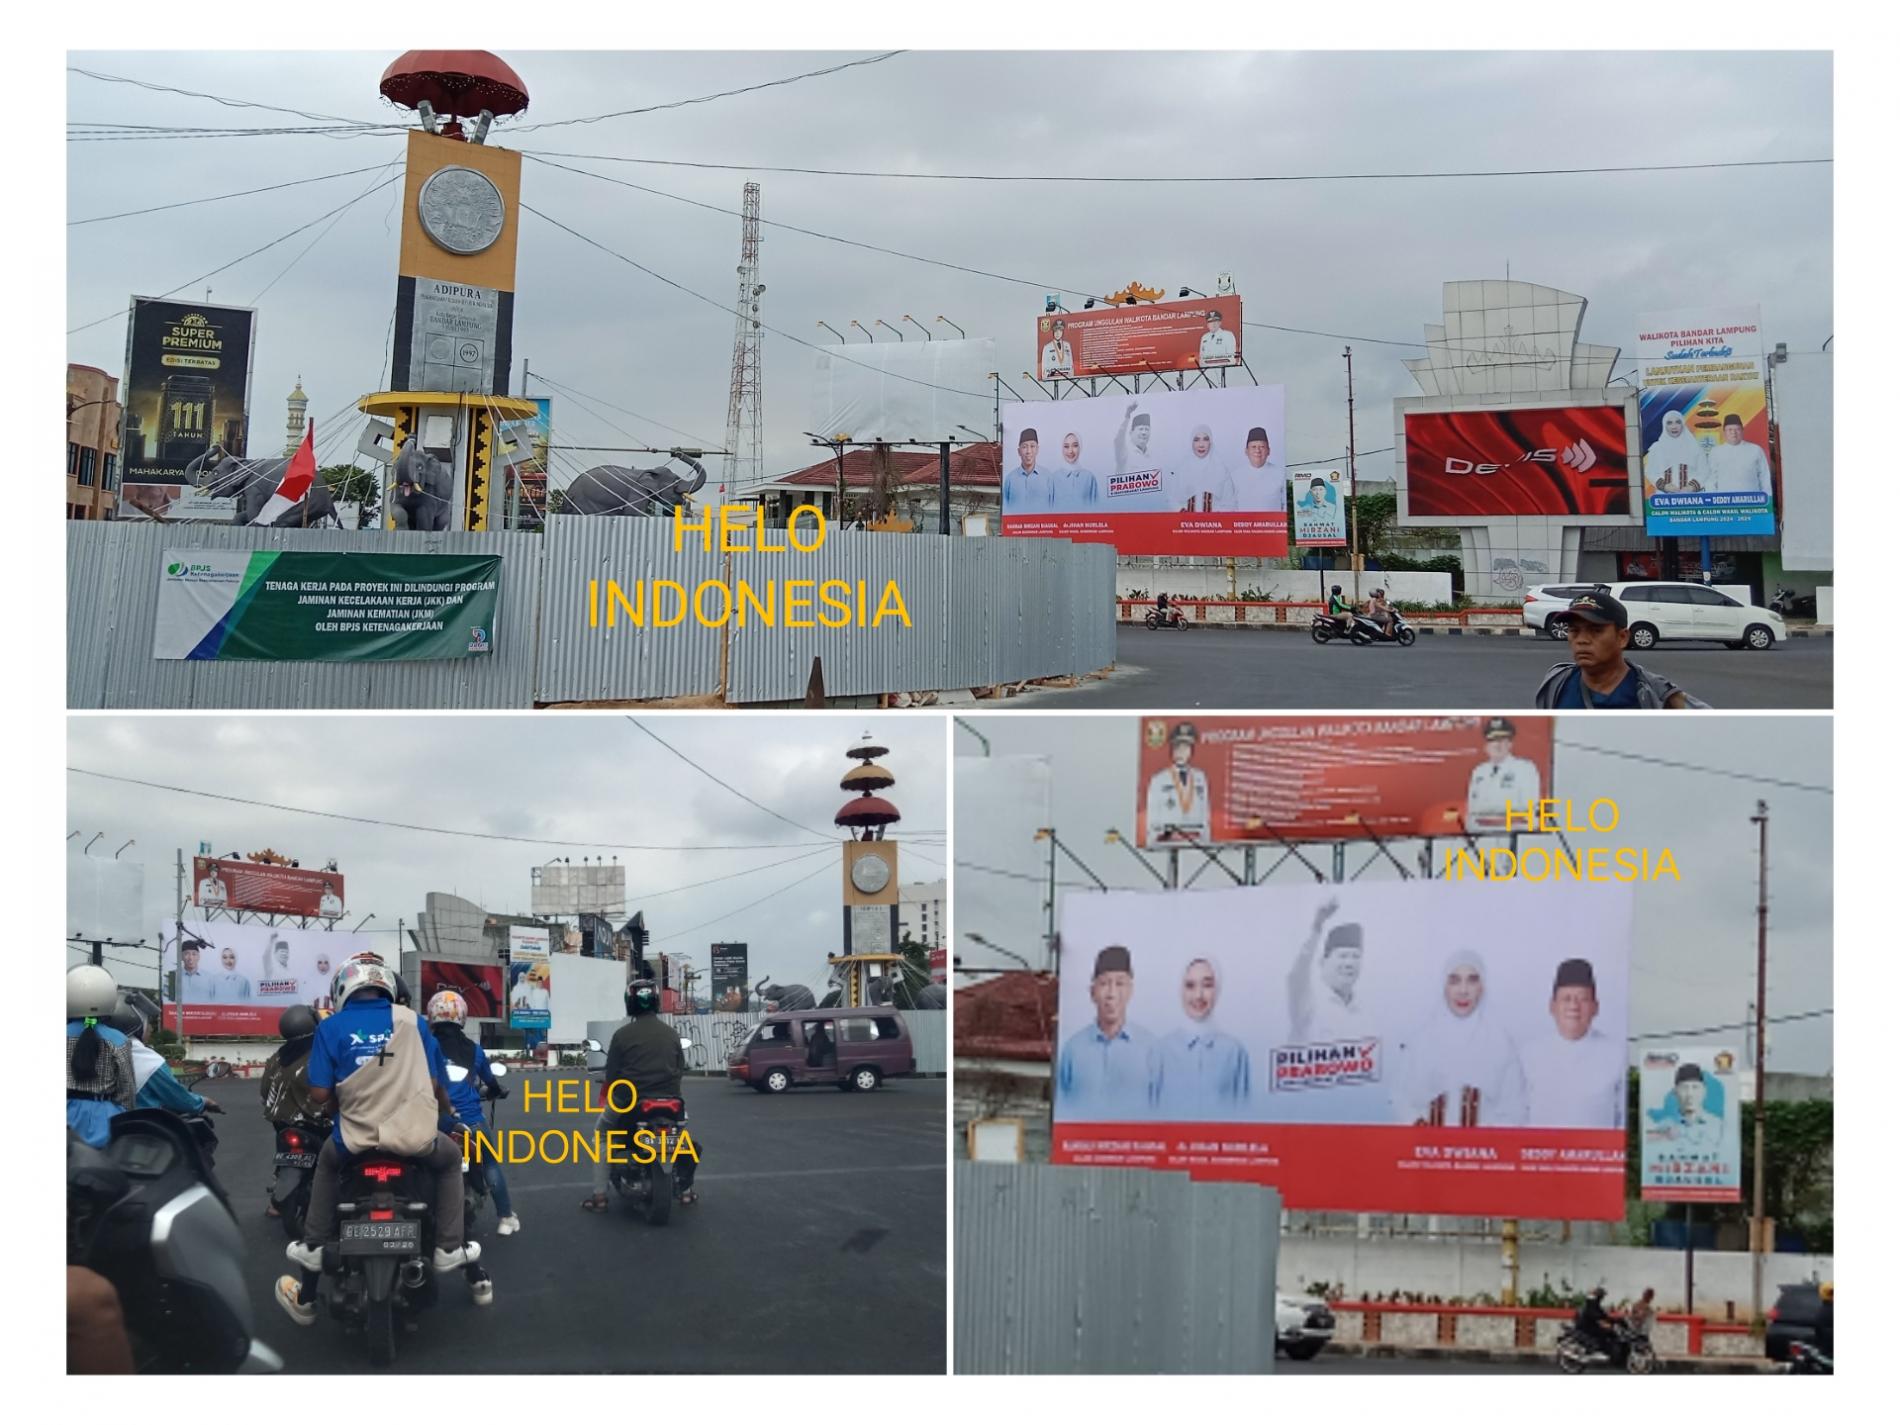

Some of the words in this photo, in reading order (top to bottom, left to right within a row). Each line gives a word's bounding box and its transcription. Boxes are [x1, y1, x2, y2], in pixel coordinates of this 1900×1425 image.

[433, 284, 481, 299] ADIPURA
[172, 326, 215, 339] SUPER
[1639, 332, 1679, 341] WALIKOTA
[1680, 328, 1714, 338] BANDAR
[1716, 325, 1757, 335] LAMPUNG
[162, 336, 222, 350] PREMIUM
[1670, 339, 1704, 347] PILIHAN
[462, 350, 476, 358] 1997
[184, 358, 216, 366] TERBATAS
[170, 402, 205, 430] 111
[129, 467, 185, 477] MAHAKARYA
[1110, 474, 1150, 484] PILIHAN
[1110, 480, 1159, 492] PRABOWO
[1654, 498, 1670, 506] EVA
[1671, 497, 1704, 505] DWIANA
[190, 564, 212, 572] BPJS
[265, 582, 299, 591] TENAGA
[300, 582, 328, 592] KERJA
[329, 582, 353, 592] PADA
[354, 583, 389, 592] PROYEK
[390, 583, 403, 592] INI
[404, 583, 453, 592] DILINDUNGI
[454, 581, 496, 592] PROGRAM
[298, 595, 337, 605] JAMINAN
[338, 596, 394, 606] KECELAKAAN
[396, 596, 422, 606] KERJA
[423, 596, 446, 607] (JKK)
[446, 595, 464, 605] DAN
[326, 608, 366, 618] JAMINAN
[366, 609, 410, 619] KEMATIAN
[411, 609, 435, 620] (JKM)
[315, 622, 338, 632] OLEH
[340, 622, 361, 632] BPJS
[362, 621, 444, 632] KETENAGAKERJAAN
[363, 1226, 391, 1238] 2529
